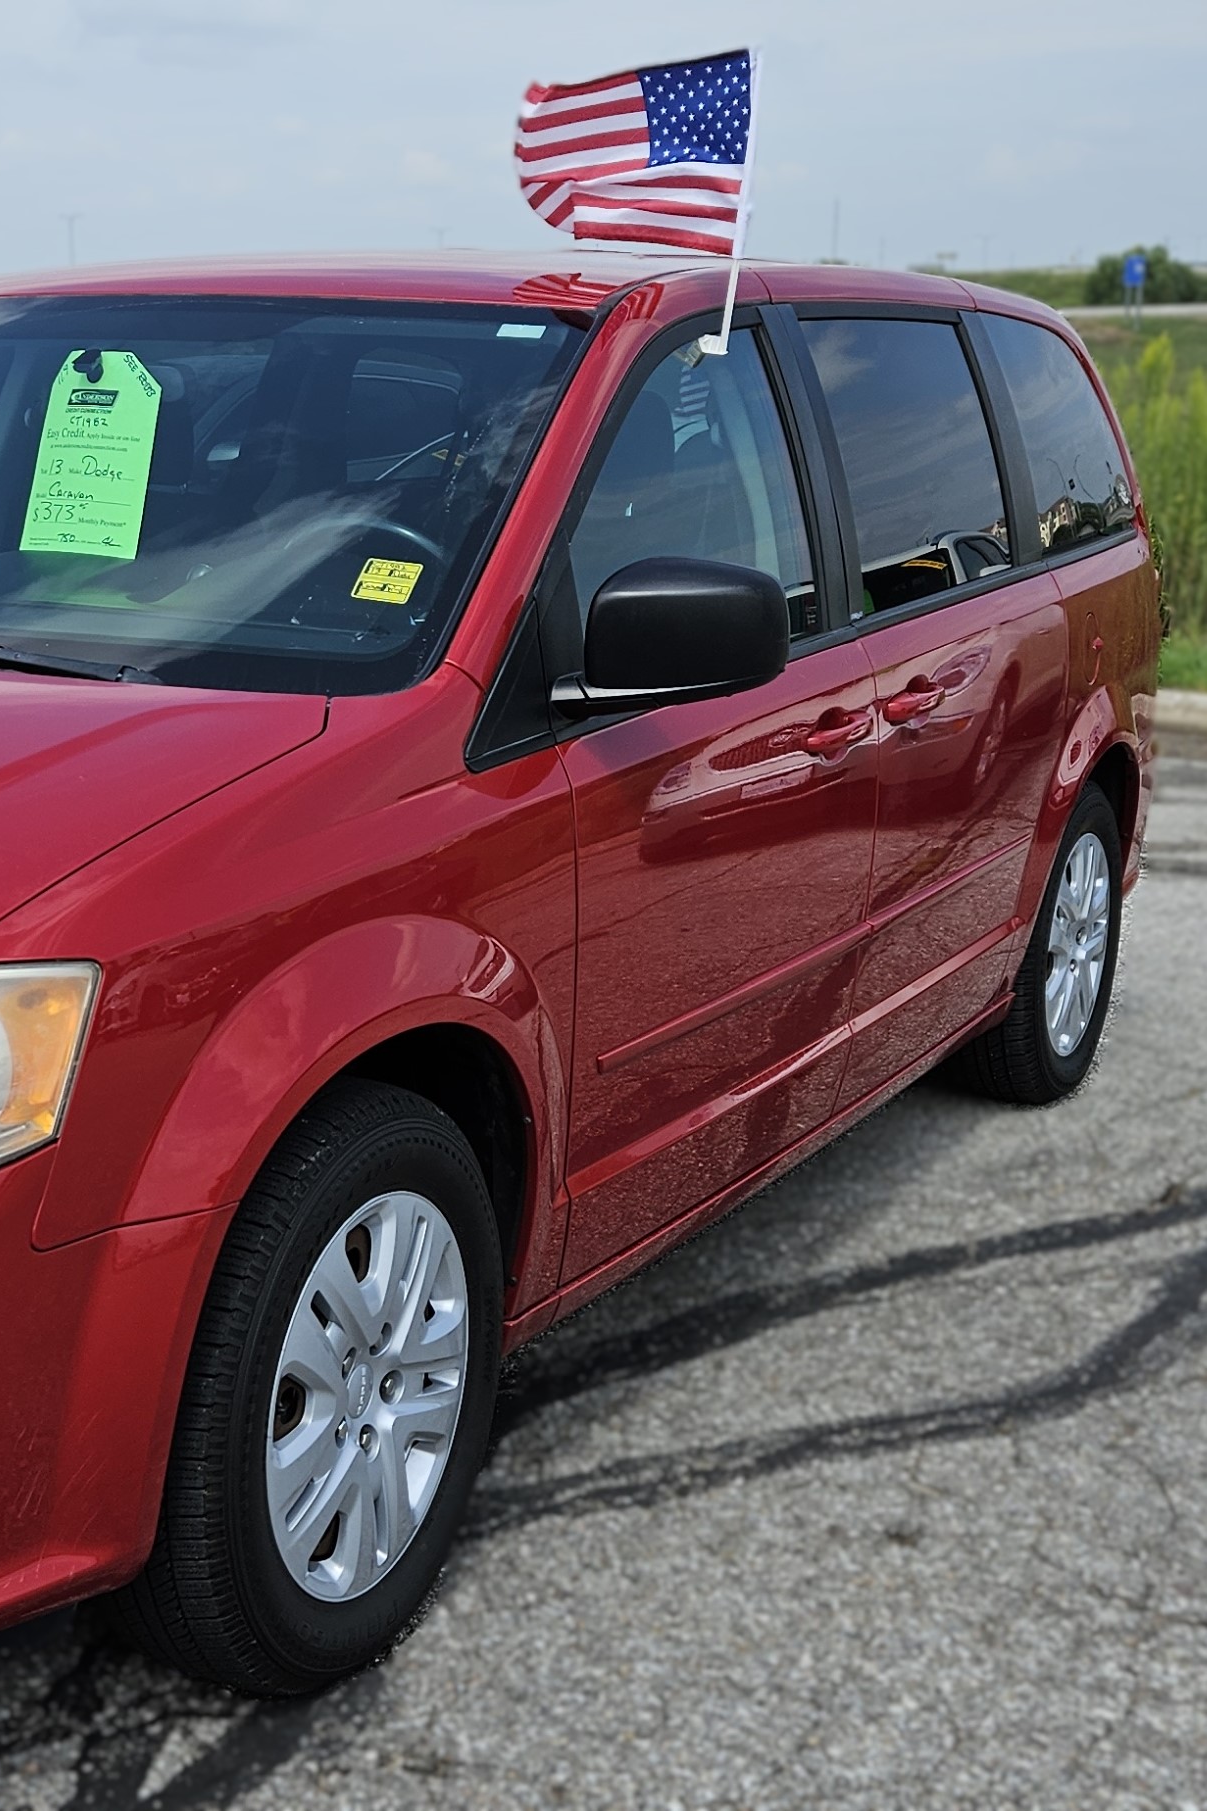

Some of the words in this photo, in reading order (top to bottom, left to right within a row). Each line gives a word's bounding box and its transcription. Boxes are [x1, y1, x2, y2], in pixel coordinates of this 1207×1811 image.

[47, 428, 60, 441] Easy
[61, 427, 85, 439] Credit
[81, 455, 123, 481] Dodge
[78, 517, 99, 527] Monthly
